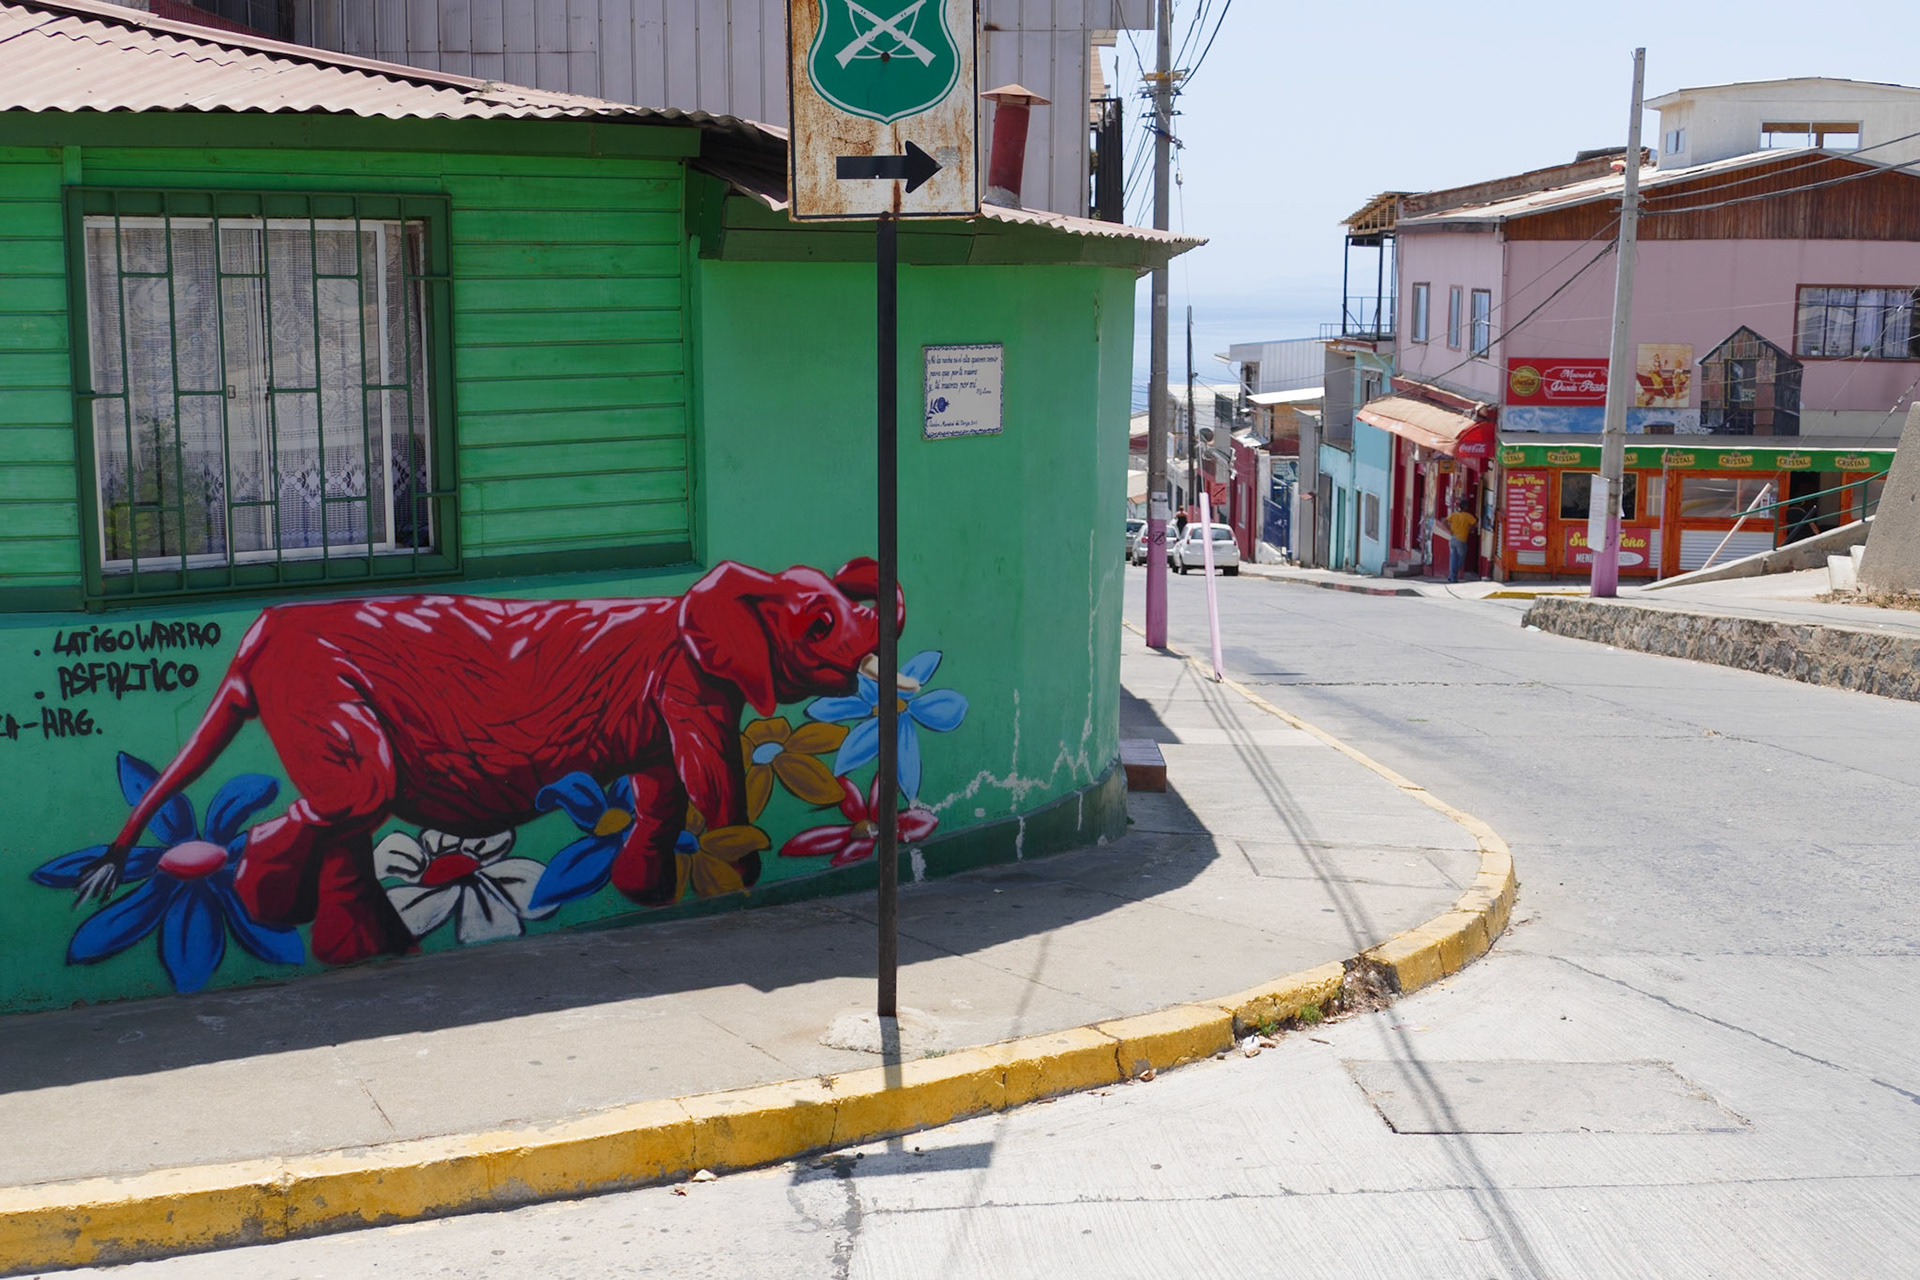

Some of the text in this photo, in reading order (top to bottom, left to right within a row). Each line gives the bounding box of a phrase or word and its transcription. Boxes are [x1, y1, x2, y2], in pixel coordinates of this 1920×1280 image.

[1549, 453, 1578, 463] CRISTAL
[1720, 456, 1751, 466] CRISTAL
[1777, 457, 1809, 467] CRISTAL
[1836, 459, 1867, 468] CRISTAL
